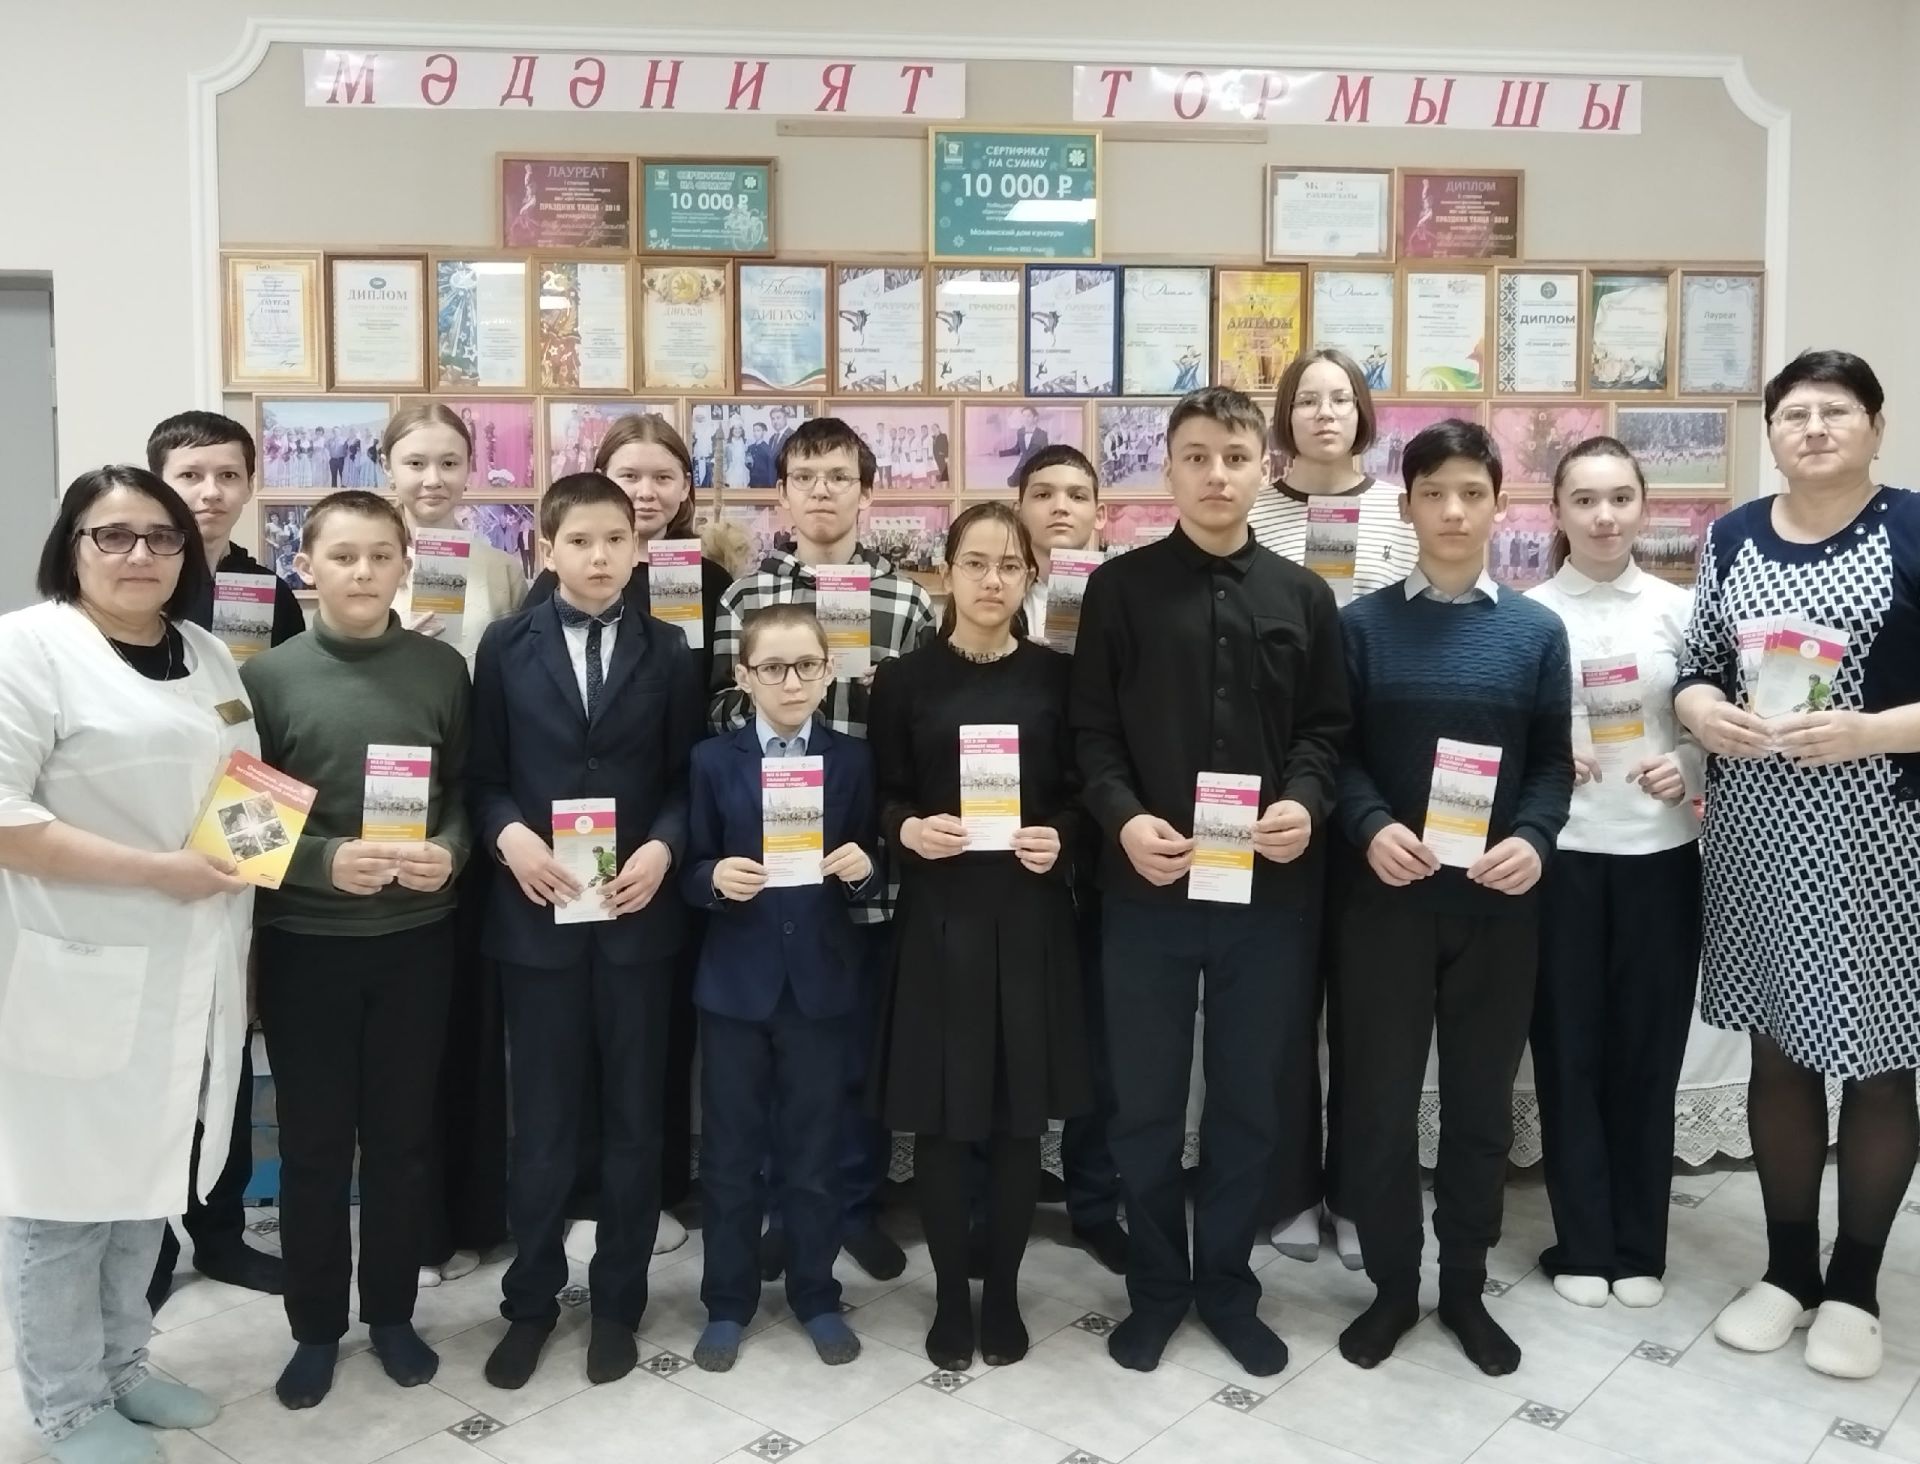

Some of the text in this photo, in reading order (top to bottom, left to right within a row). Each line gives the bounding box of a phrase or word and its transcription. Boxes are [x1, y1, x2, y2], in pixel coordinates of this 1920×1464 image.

[326, 53, 933, 115] МӘДӘНИЯТ
[1099, 68, 1630, 130] ТОРМЫШЫ
[985, 146, 1050, 157] СЕРТИФИКАТ
[988, 158, 1048, 169] НА СУММУ
[546, 166, 608, 179] ЛАУРЕАТ
[961, 173, 993, 198] 10
[1000, 174, 1050, 198] 000
[1445, 182, 1497, 193] ДИПЛОМ
[670, 192, 693, 209] 10
[697, 193, 734, 210] 000
[347, 289, 408, 301] ДИПЛОМ
[750, 308, 816, 322] ДИПЛОМ
[1519, 314, 1576, 325] ДИПЛОМ
[1703, 311, 1737, 320] Лауреат
[1227, 316, 1294, 331] ДИПЛОМ
